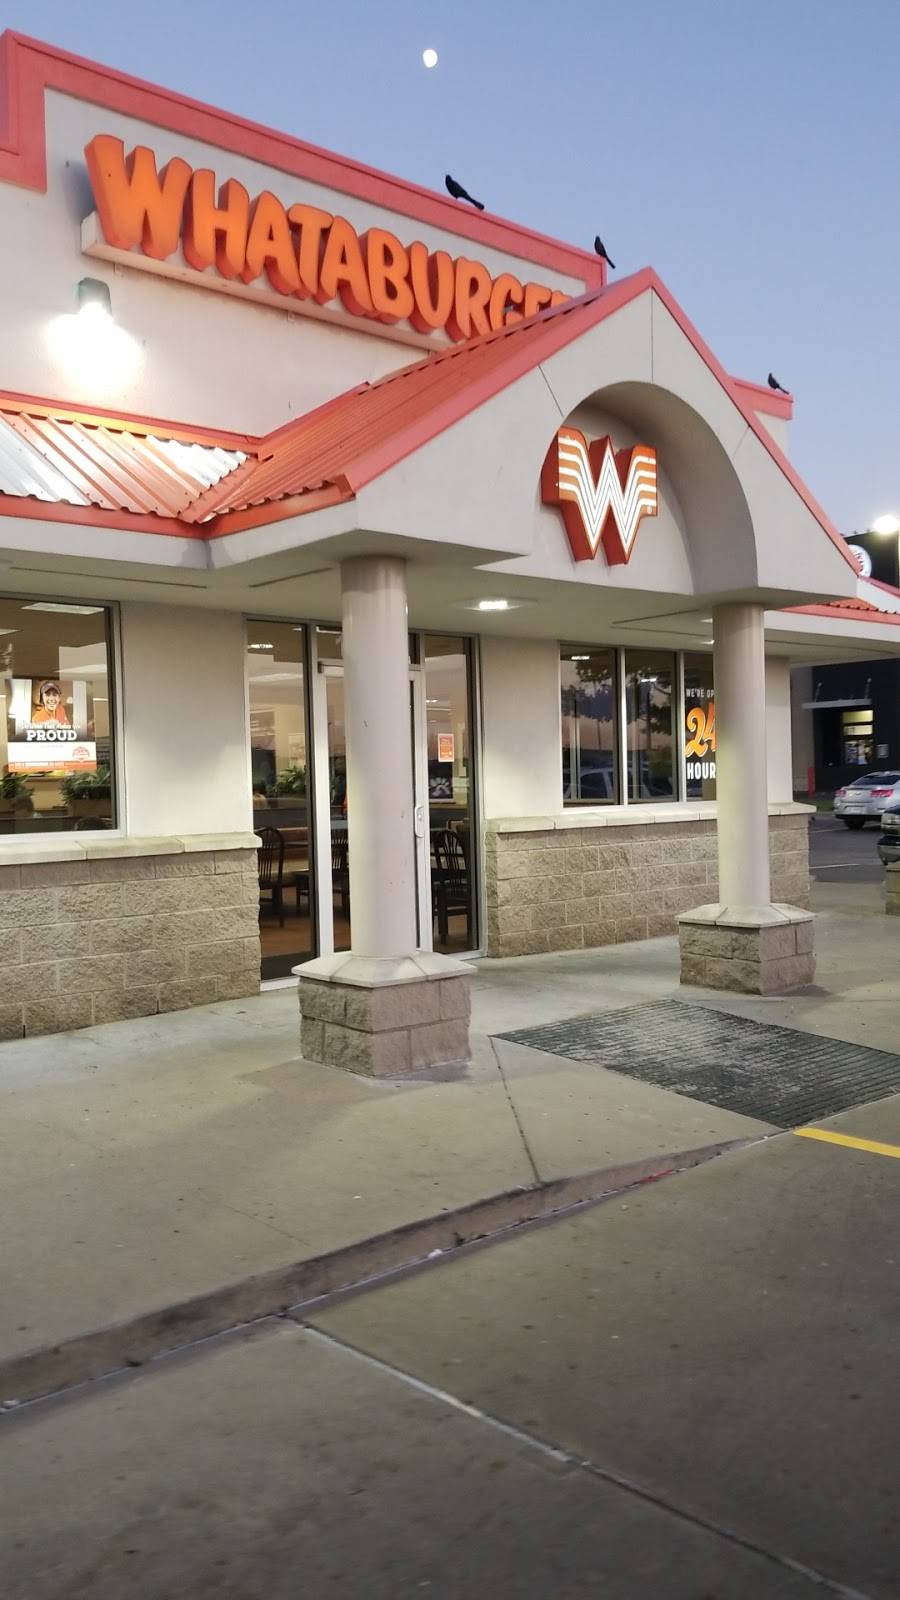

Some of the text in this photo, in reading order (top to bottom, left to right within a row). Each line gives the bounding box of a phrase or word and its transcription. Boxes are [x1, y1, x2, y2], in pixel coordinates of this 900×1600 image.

[84, 134, 574, 342] WHATABURGE
[686, 688, 715, 698] WE'RE OP
[26, 729, 78, 741] PROUD
[685, 702, 717, 757] 24
[687, 762, 716, 779] HOUR
